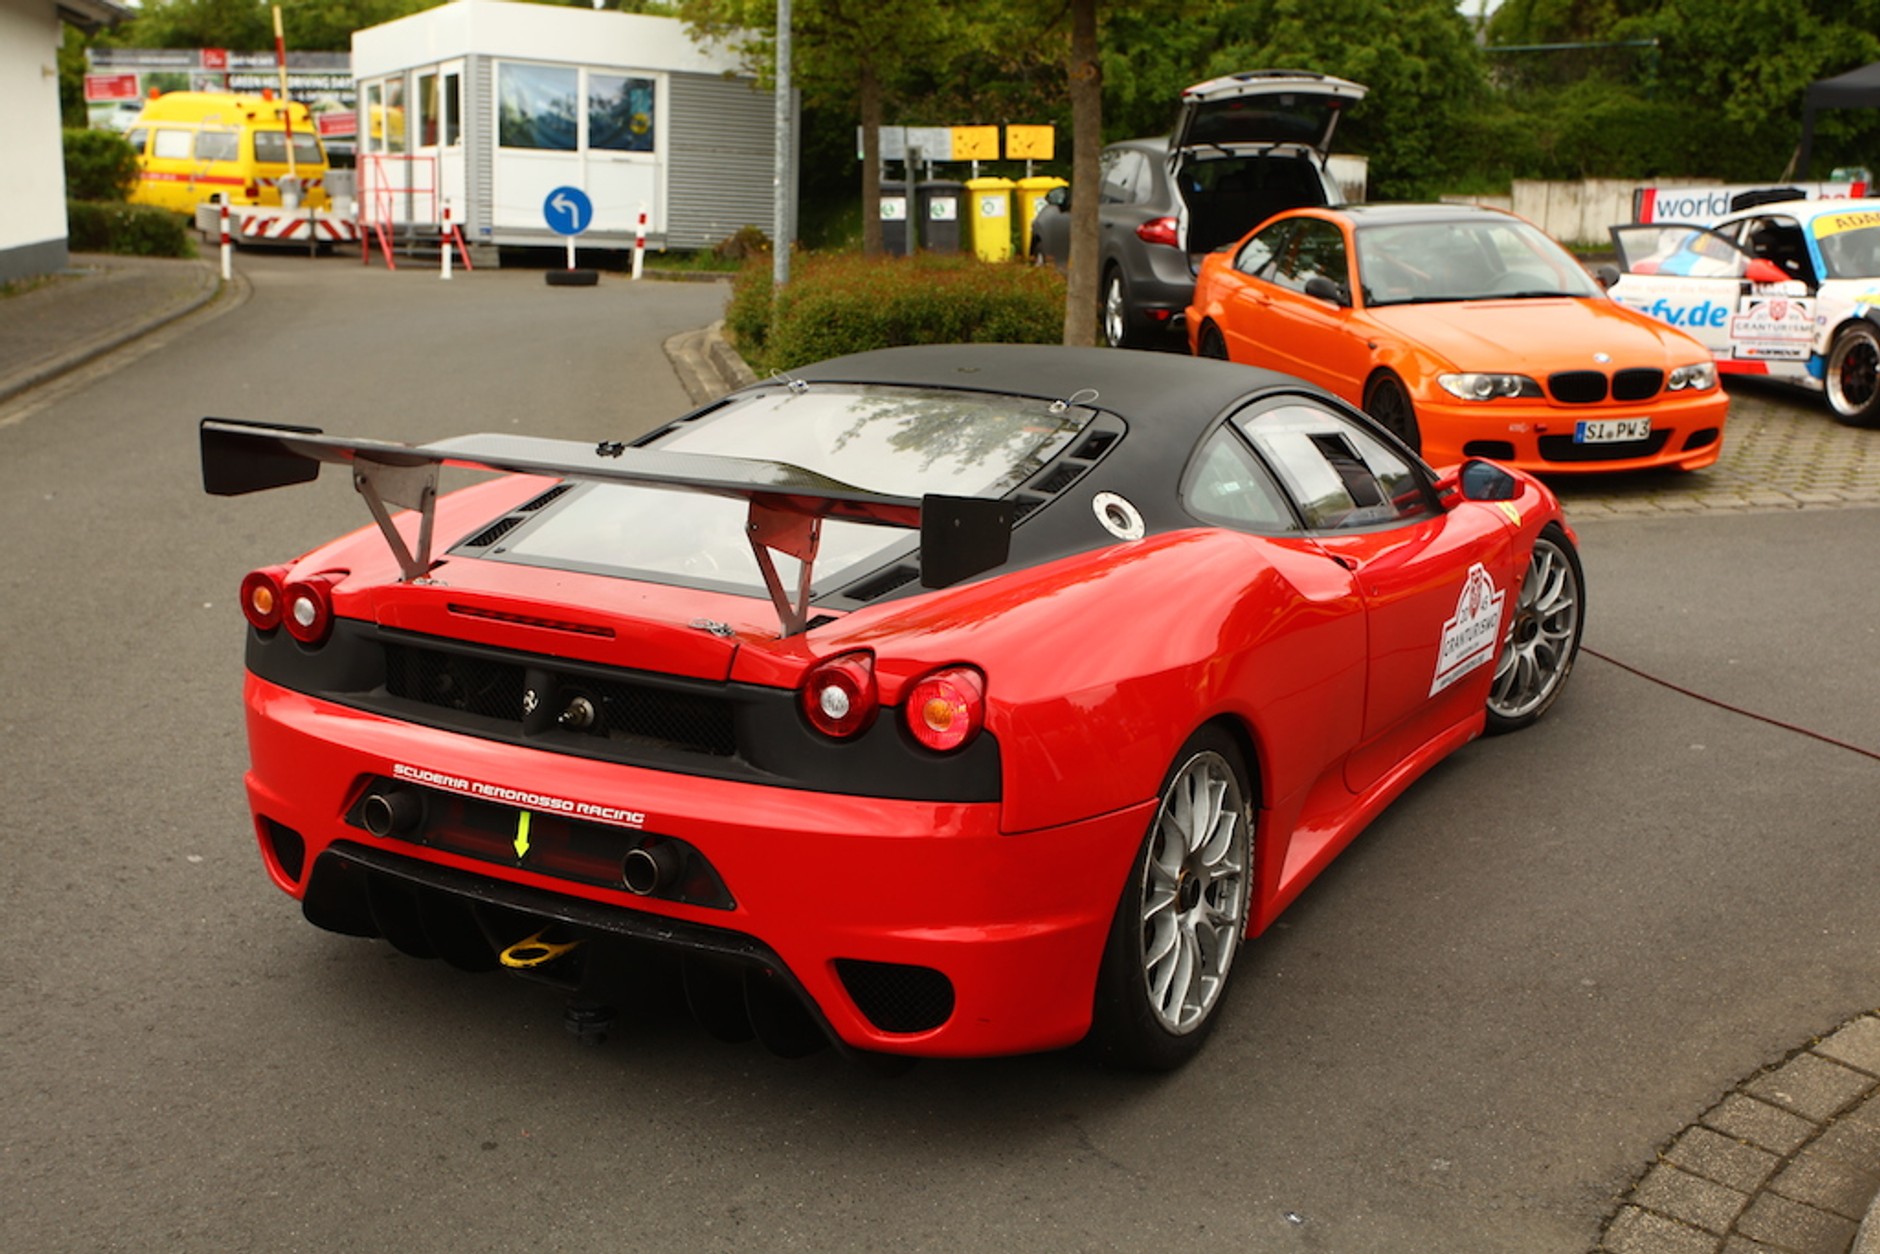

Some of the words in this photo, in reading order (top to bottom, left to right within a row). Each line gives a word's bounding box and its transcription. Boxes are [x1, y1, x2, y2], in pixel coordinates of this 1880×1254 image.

[393, 763, 469, 791] SCUDERIA
[472, 782, 574, 811] NEROROSSO
[576, 802, 645, 824] RACING
